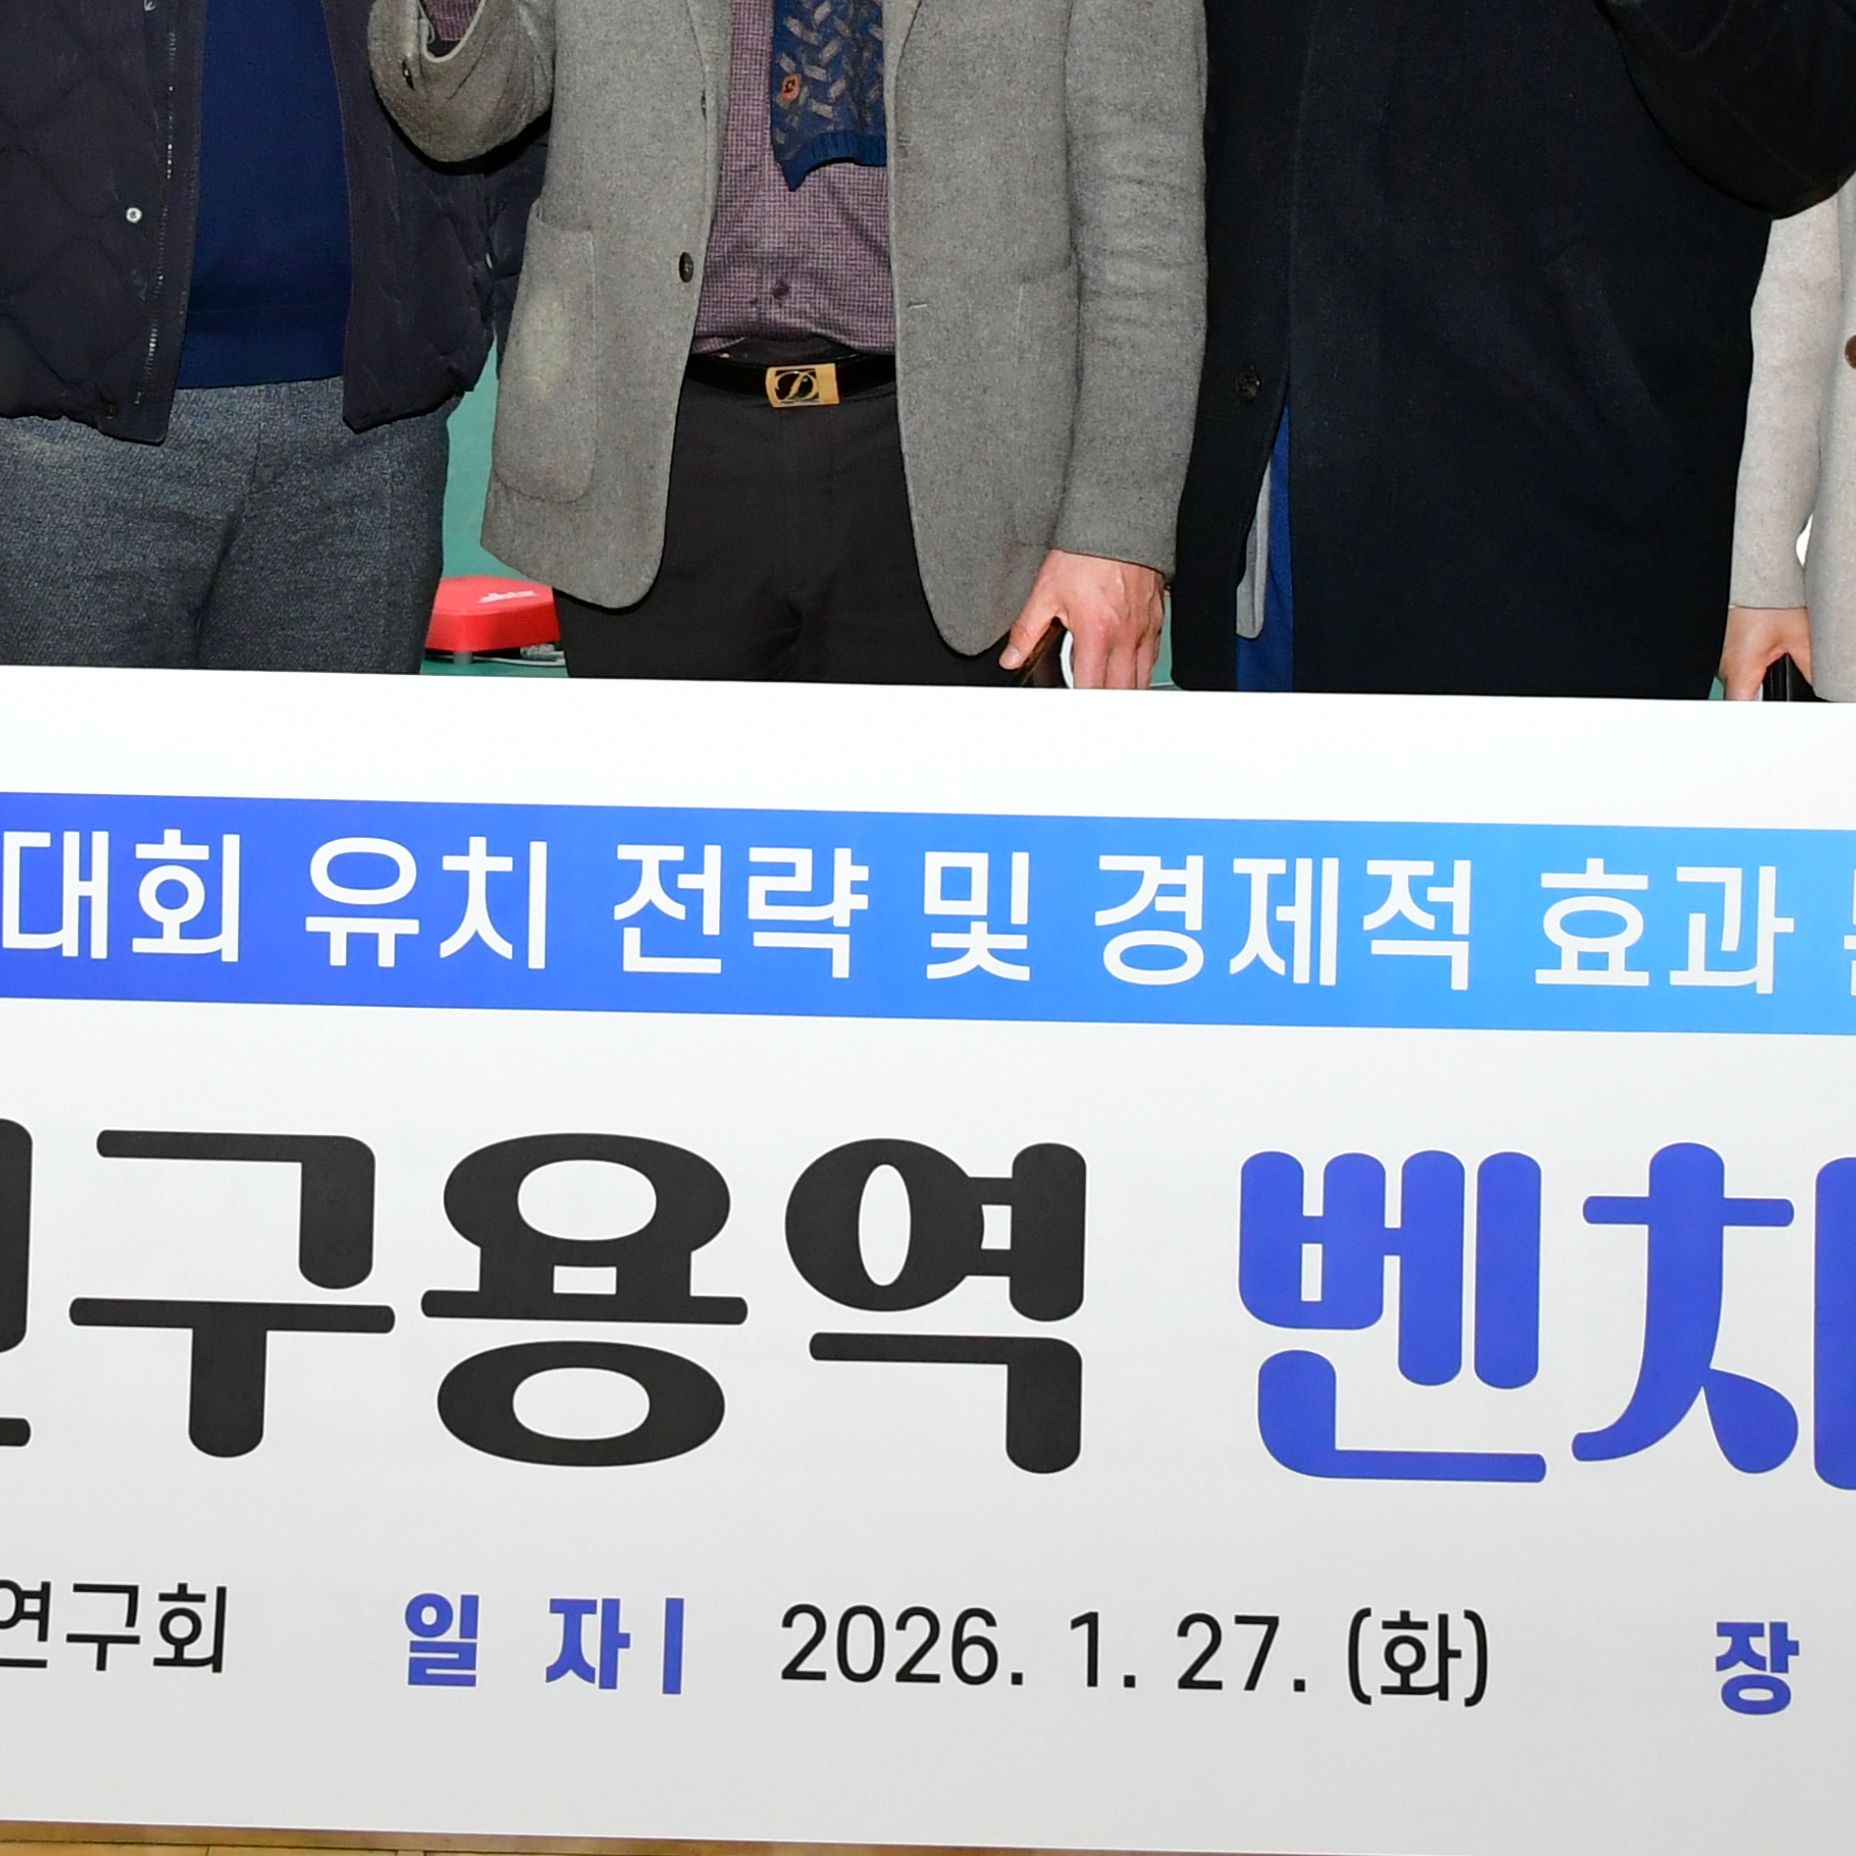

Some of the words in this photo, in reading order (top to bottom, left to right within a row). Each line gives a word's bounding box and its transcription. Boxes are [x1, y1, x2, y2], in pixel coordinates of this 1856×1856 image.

[305, 836, 548, 970] 유치
[614, 844, 870, 979] 전략
[924, 851, 1031, 981] 및
[1095, 855, 1472, 991] 경제적
[1535, 857, 1796, 995] 효과
[781, 1603, 1023, 1686] 2026.
[1070, 1611, 1136, 1689] 1.
[1177, 1612, 1306, 1693] 27.
[1348, 1607, 1488, 1708] (화)
